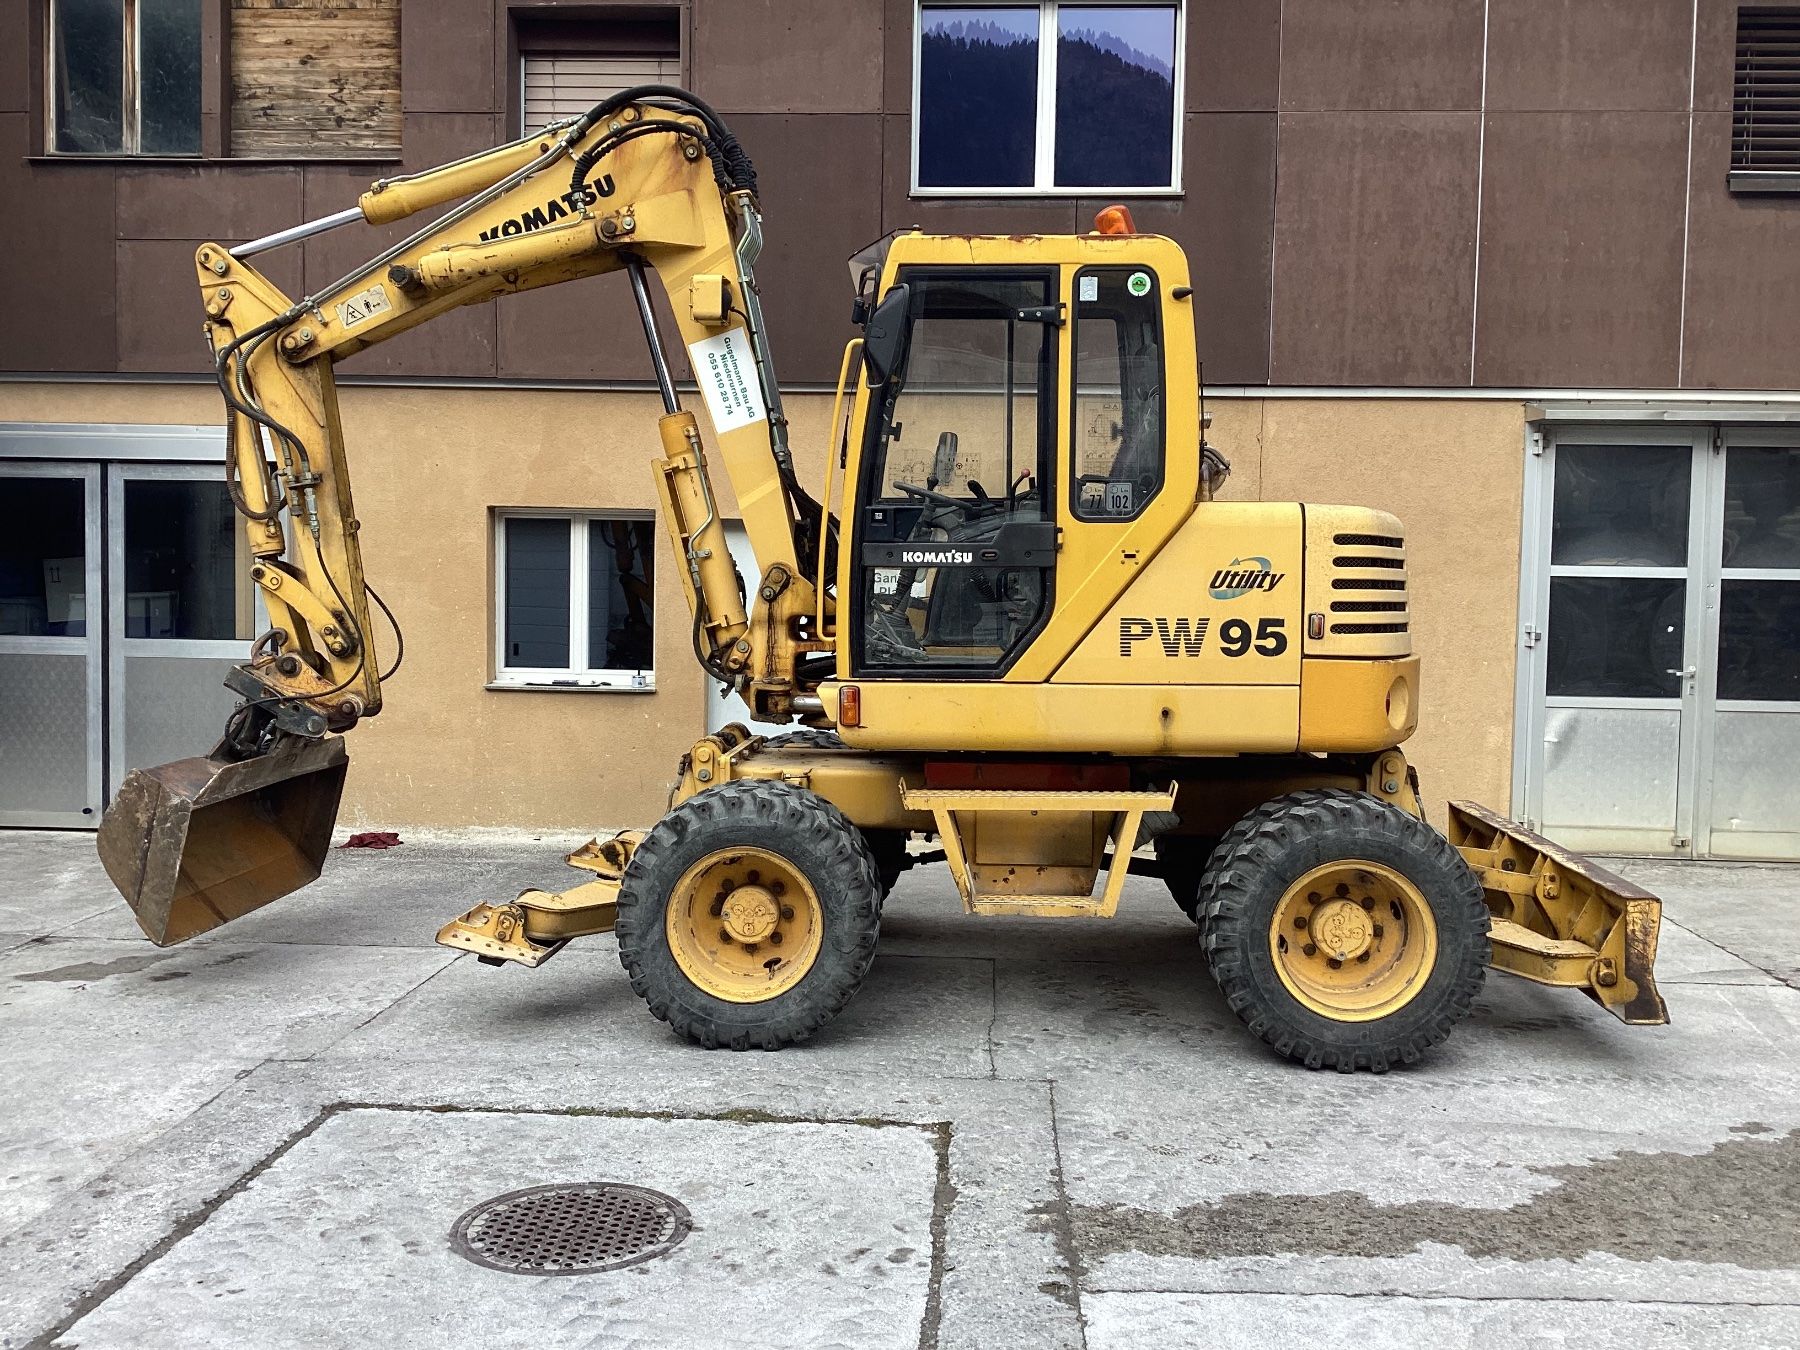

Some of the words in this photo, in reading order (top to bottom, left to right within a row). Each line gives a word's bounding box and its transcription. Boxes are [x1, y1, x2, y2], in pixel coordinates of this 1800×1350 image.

[708, 353, 718, 370] 055
[714, 372, 724, 388] 610
[720, 391, 729, 402] 28
[725, 404, 733, 415] 74
[720, 354, 741, 407] Niederurnen
[724, 337, 743, 386] Gugelmann
[740, 387, 750, 404] Bau
[746, 406, 755, 418] AG
[1090, 495, 1102, 508] 77
[1112, 495, 1128, 509] 102
[902, 549, 973, 563] KOMATSU
[1209, 569, 1286, 592] Utility
[1120, 618, 1210, 657] PW
[1219, 618, 1288, 657] 95
